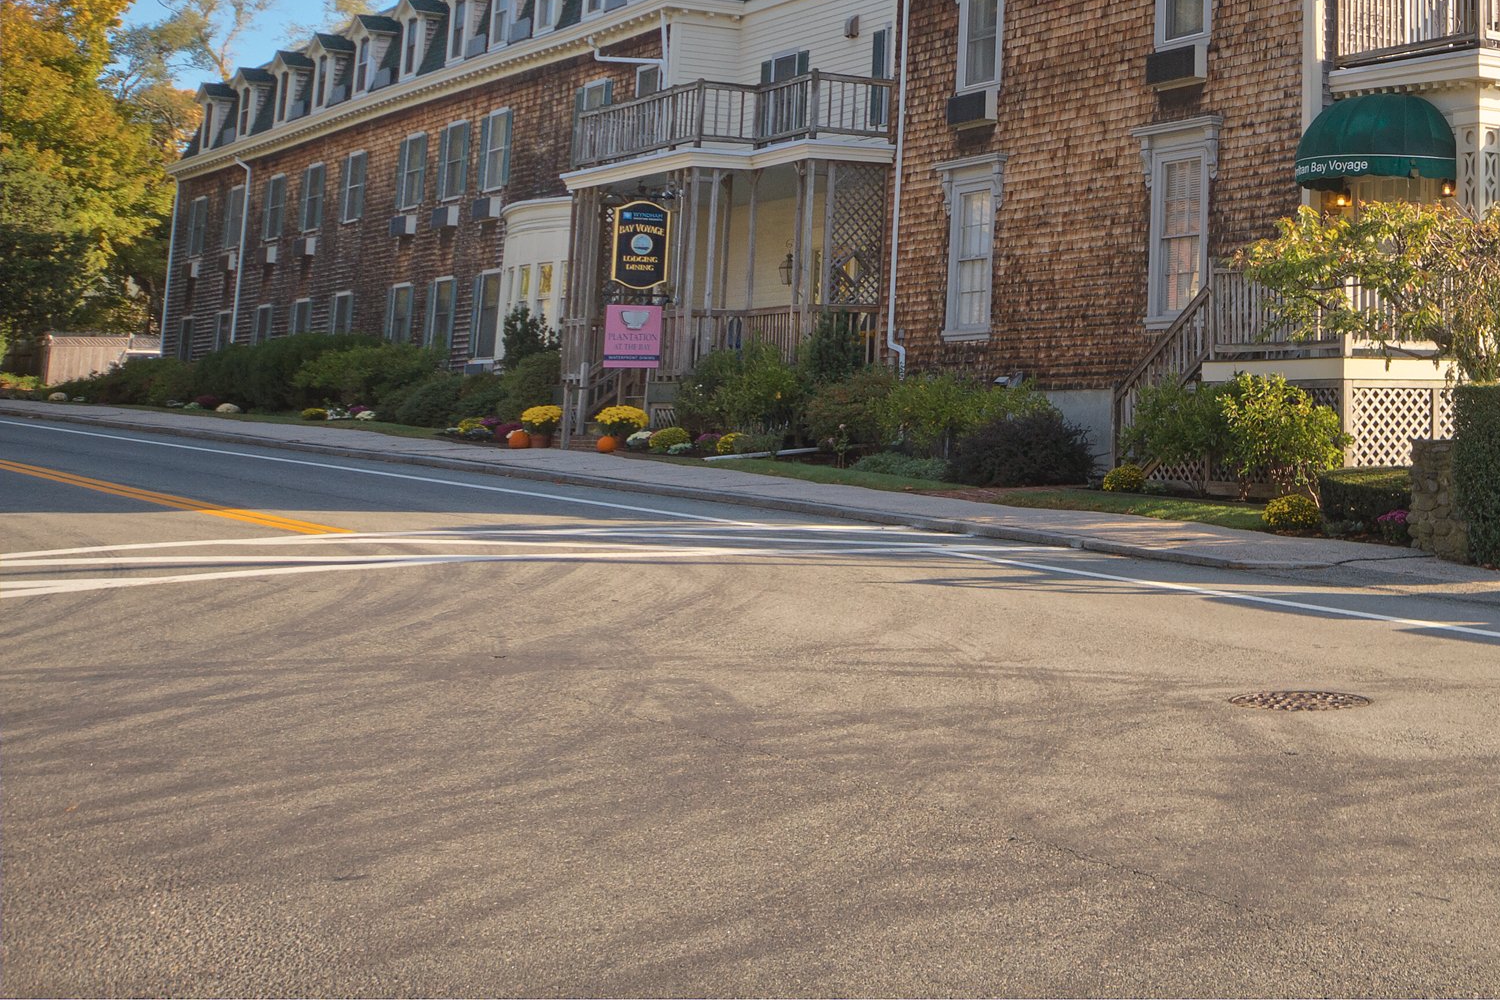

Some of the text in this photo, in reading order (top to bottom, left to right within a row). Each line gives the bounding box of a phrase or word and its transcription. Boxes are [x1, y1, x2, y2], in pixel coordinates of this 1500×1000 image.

[1310, 162, 1327, 174] Bay
[1328, 160, 1368, 173] Voyage
[619, 223, 665, 236] BAY VOYAGE
[623, 255, 658, 263] LODGING
[625, 263, 655, 271] DINING
[608, 333, 657, 341] PLANTATION
